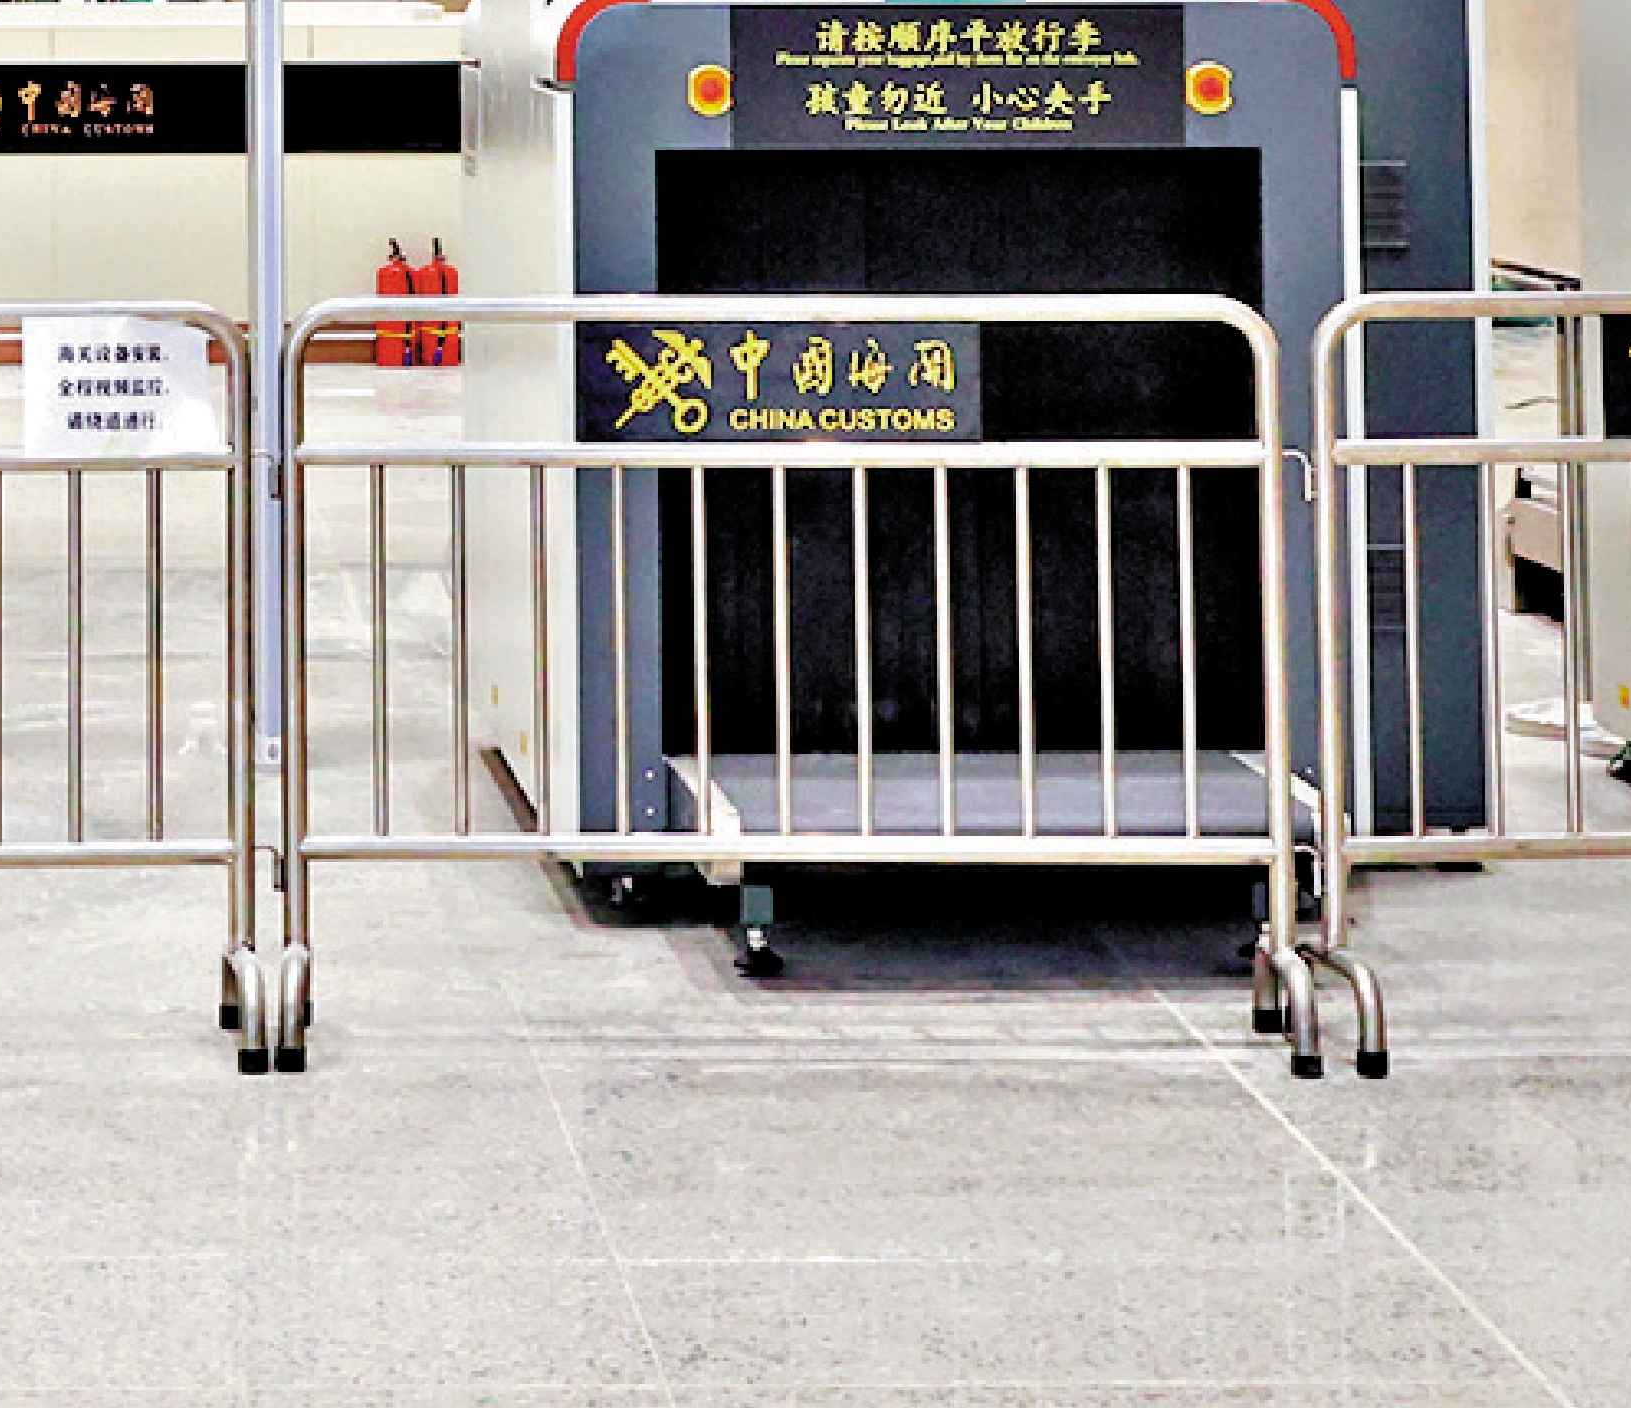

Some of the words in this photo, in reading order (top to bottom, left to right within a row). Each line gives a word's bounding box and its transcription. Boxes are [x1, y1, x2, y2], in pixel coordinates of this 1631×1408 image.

[973, 81, 1111, 114] 小心夹手
[730, 409, 813, 430] CHINA
[815, 409, 954, 432] CUSTOMS
